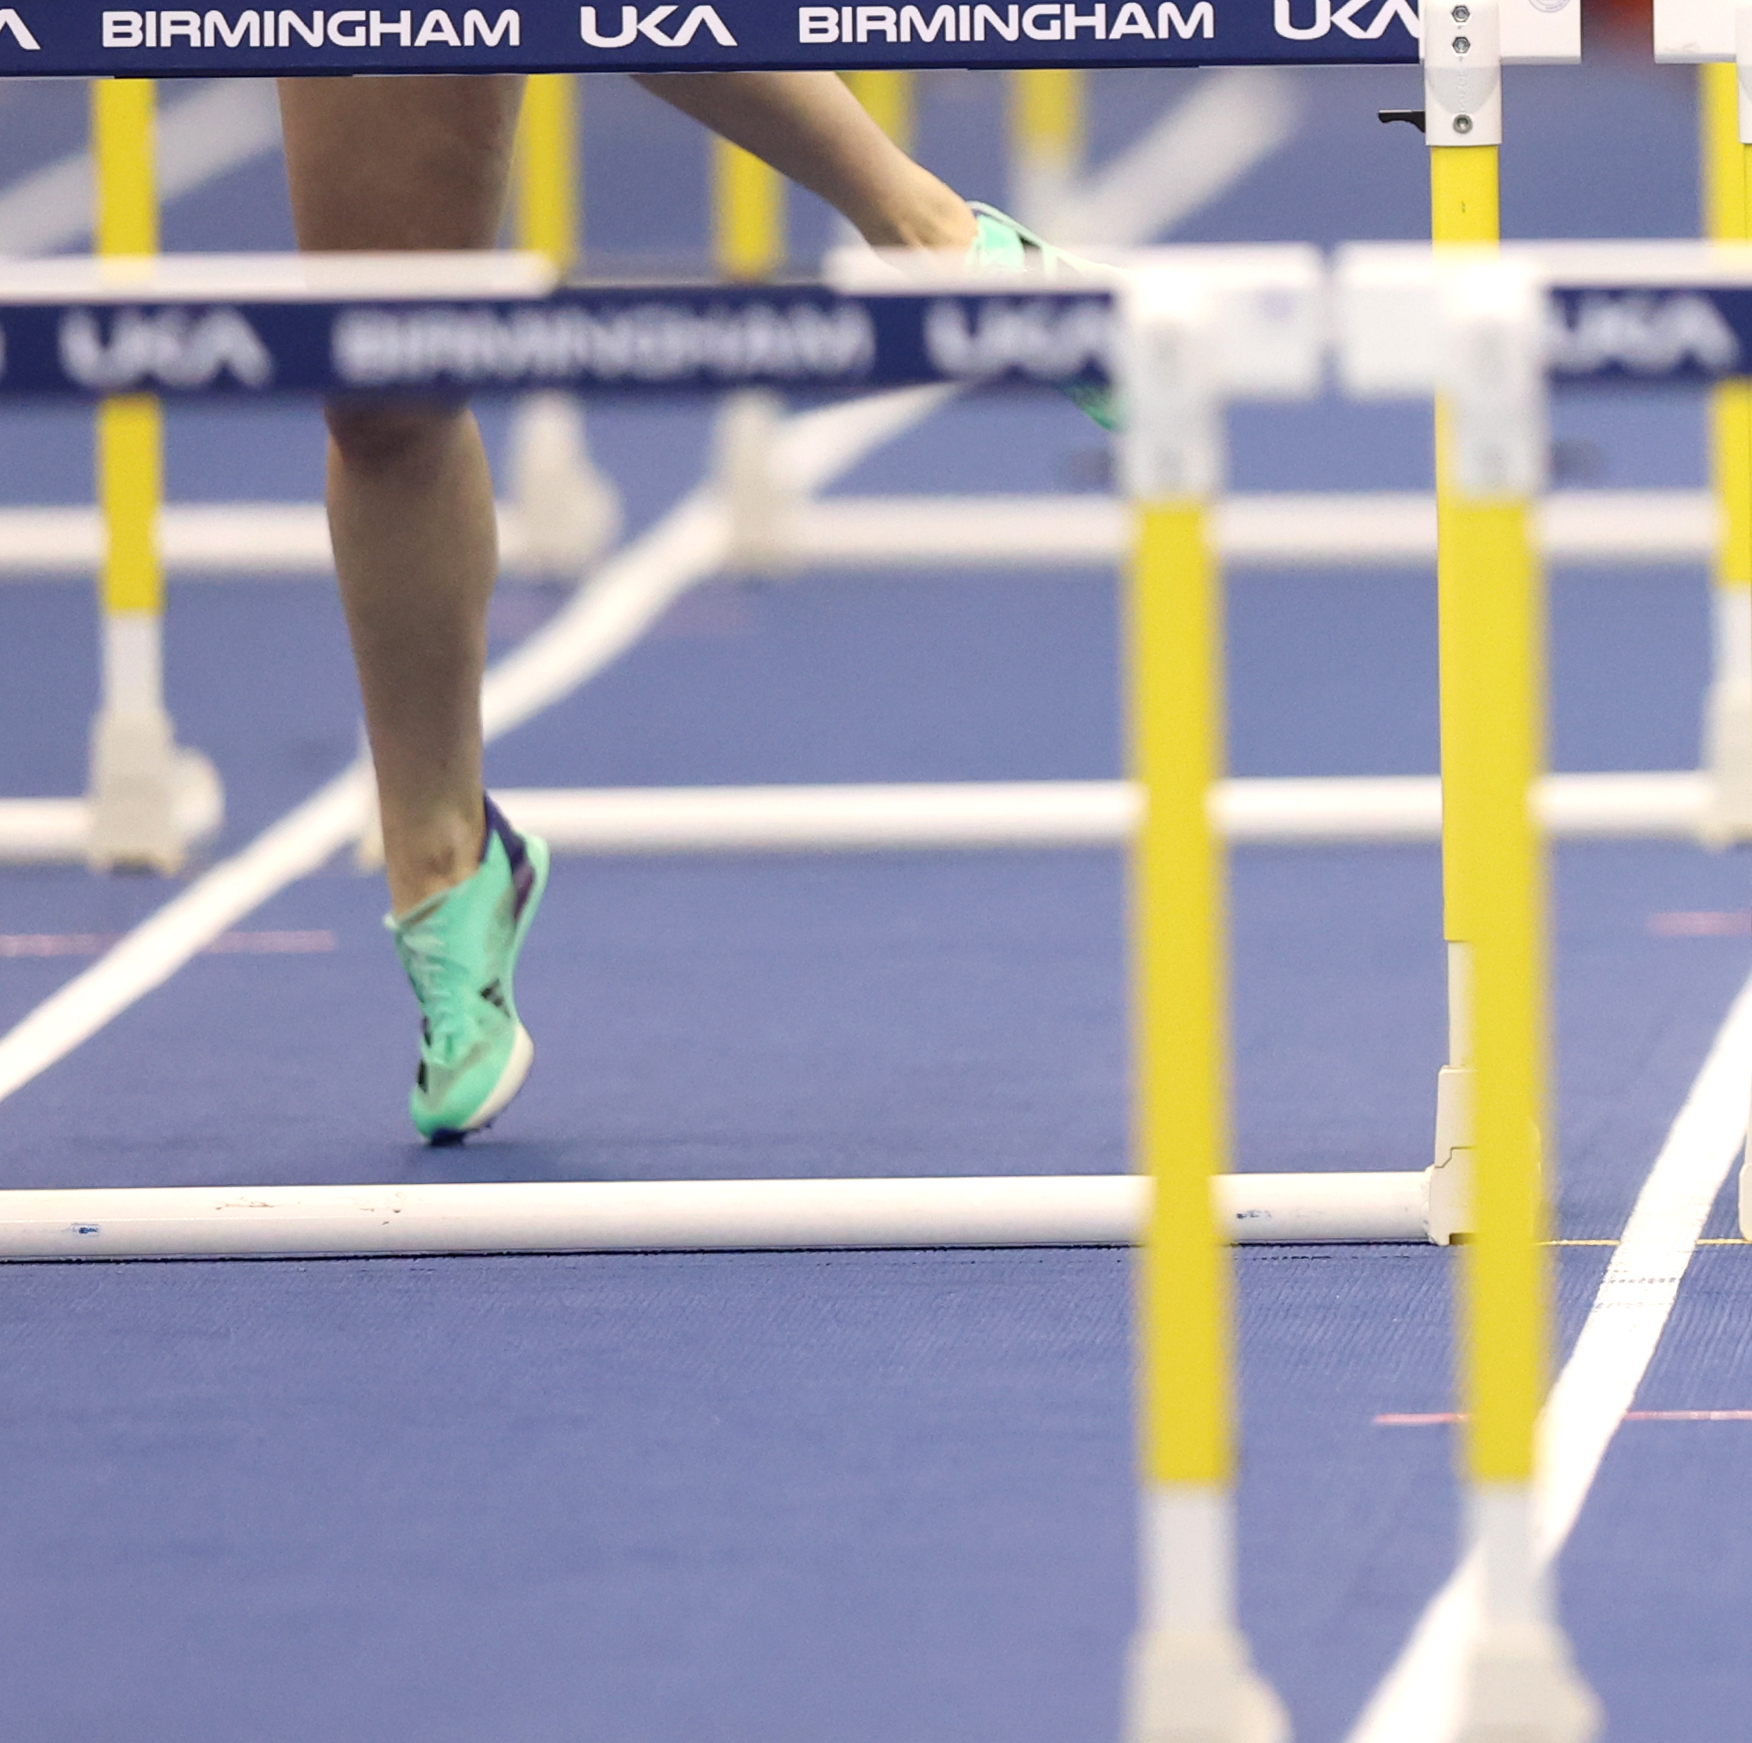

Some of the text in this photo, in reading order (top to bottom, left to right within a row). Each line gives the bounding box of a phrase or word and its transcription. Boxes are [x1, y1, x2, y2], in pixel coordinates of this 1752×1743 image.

[103, 10, 519, 48] BIRMINGHAM
[580, 5, 737, 47] UKA
[799, 2, 1213, 44] BIRMINGHAM
